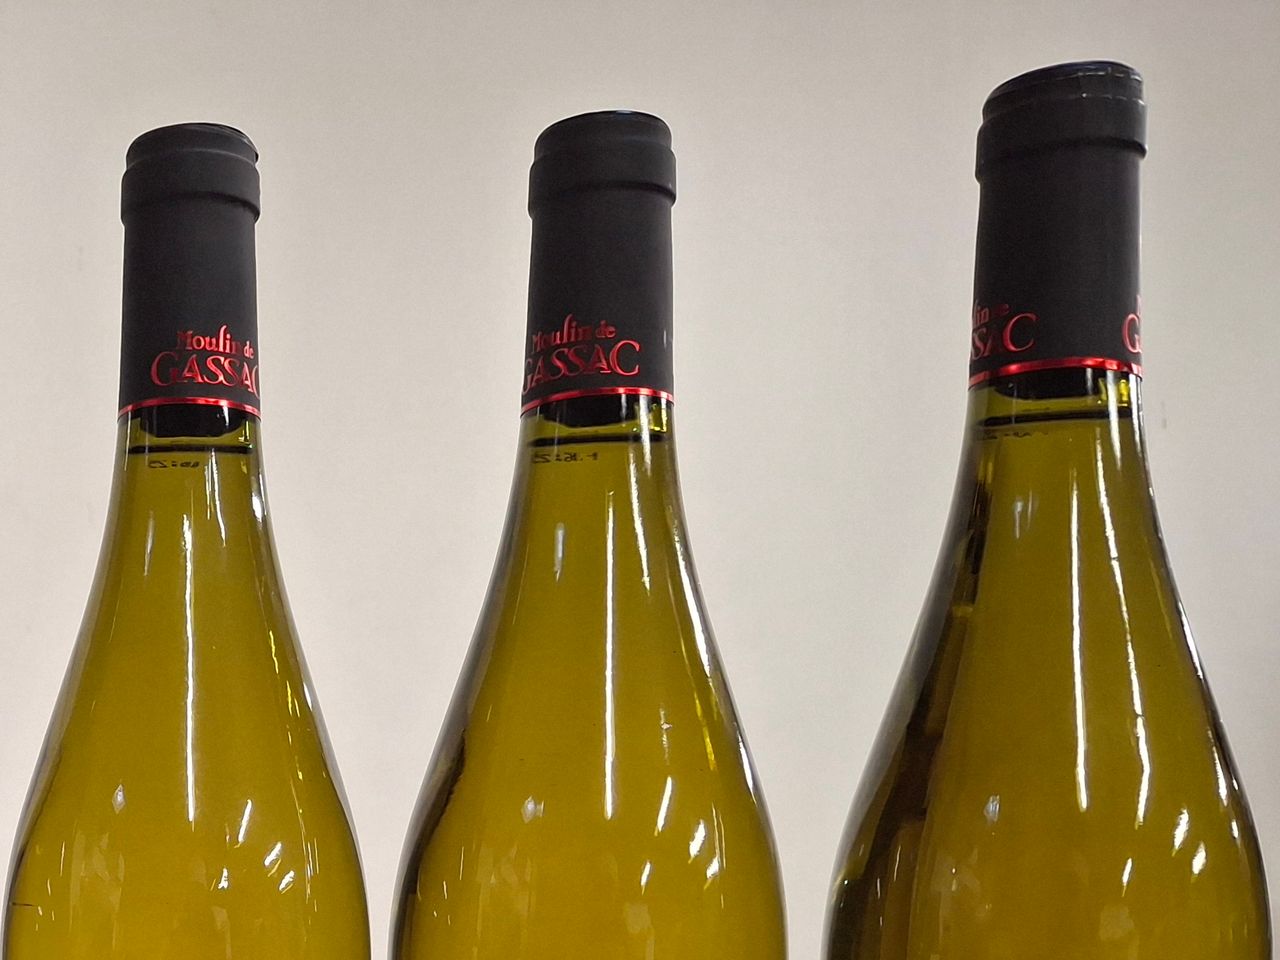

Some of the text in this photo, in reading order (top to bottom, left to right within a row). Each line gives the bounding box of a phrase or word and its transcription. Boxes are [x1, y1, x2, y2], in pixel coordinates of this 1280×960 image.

[177, 324, 254, 359] Moulin de
[596, 320, 616, 338] de
[522, 339, 640, 395] GASSAC
